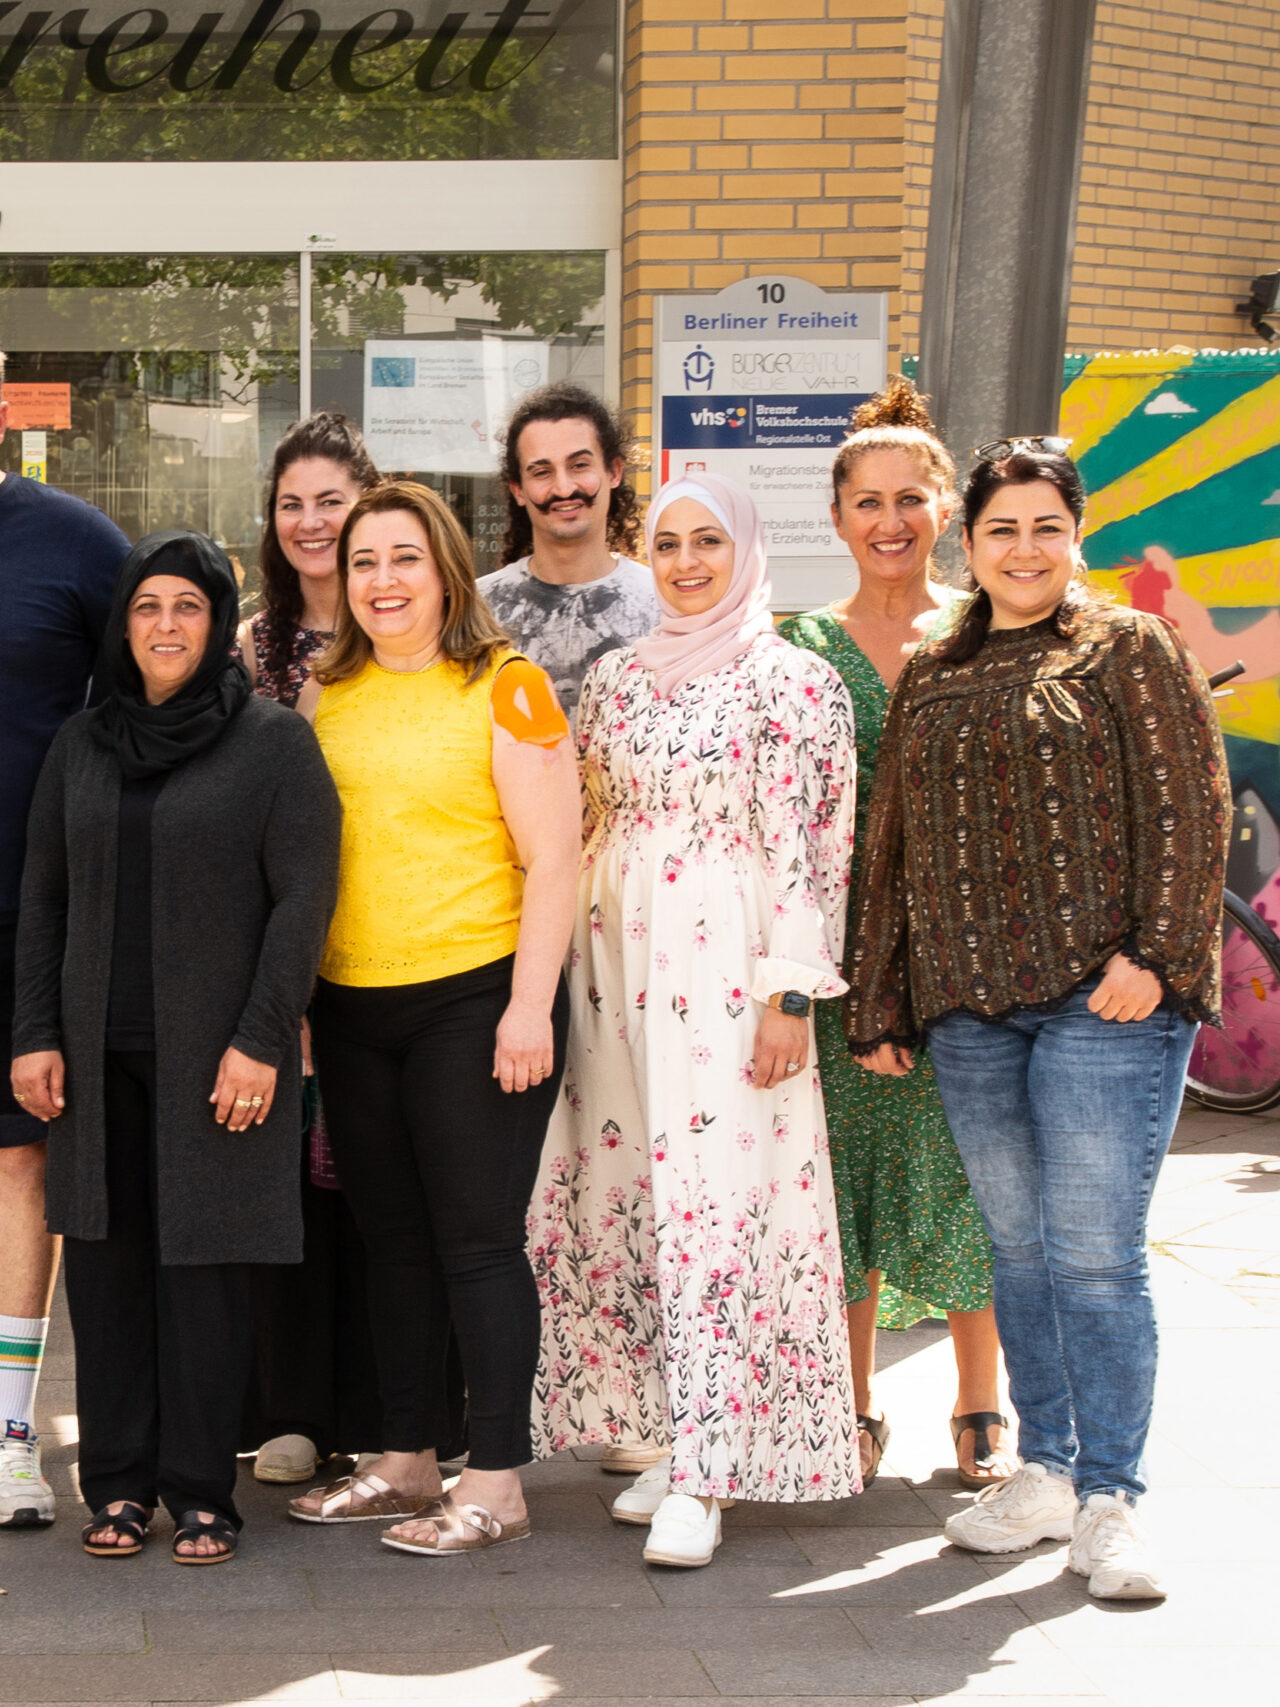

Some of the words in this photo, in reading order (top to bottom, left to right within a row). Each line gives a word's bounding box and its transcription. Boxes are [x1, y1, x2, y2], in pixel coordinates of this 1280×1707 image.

[756, 283, 786, 304] 10
[684, 313, 768, 329] Berliner
[778, 311, 859, 328] Freiheit
[731, 376, 788, 391] NEUE
[802, 375, 860, 390] VAHR
[755, 404, 799, 415] Bremer
[690, 408, 726, 426] vhs
[755, 416, 849, 427] Volkshochschule
[755, 434, 815, 446] Regionalstelle
[816, 433, 832, 443] Ost
[478, 522, 506, 535] 9.00
[771, 532, 832, 546] Erziehung
